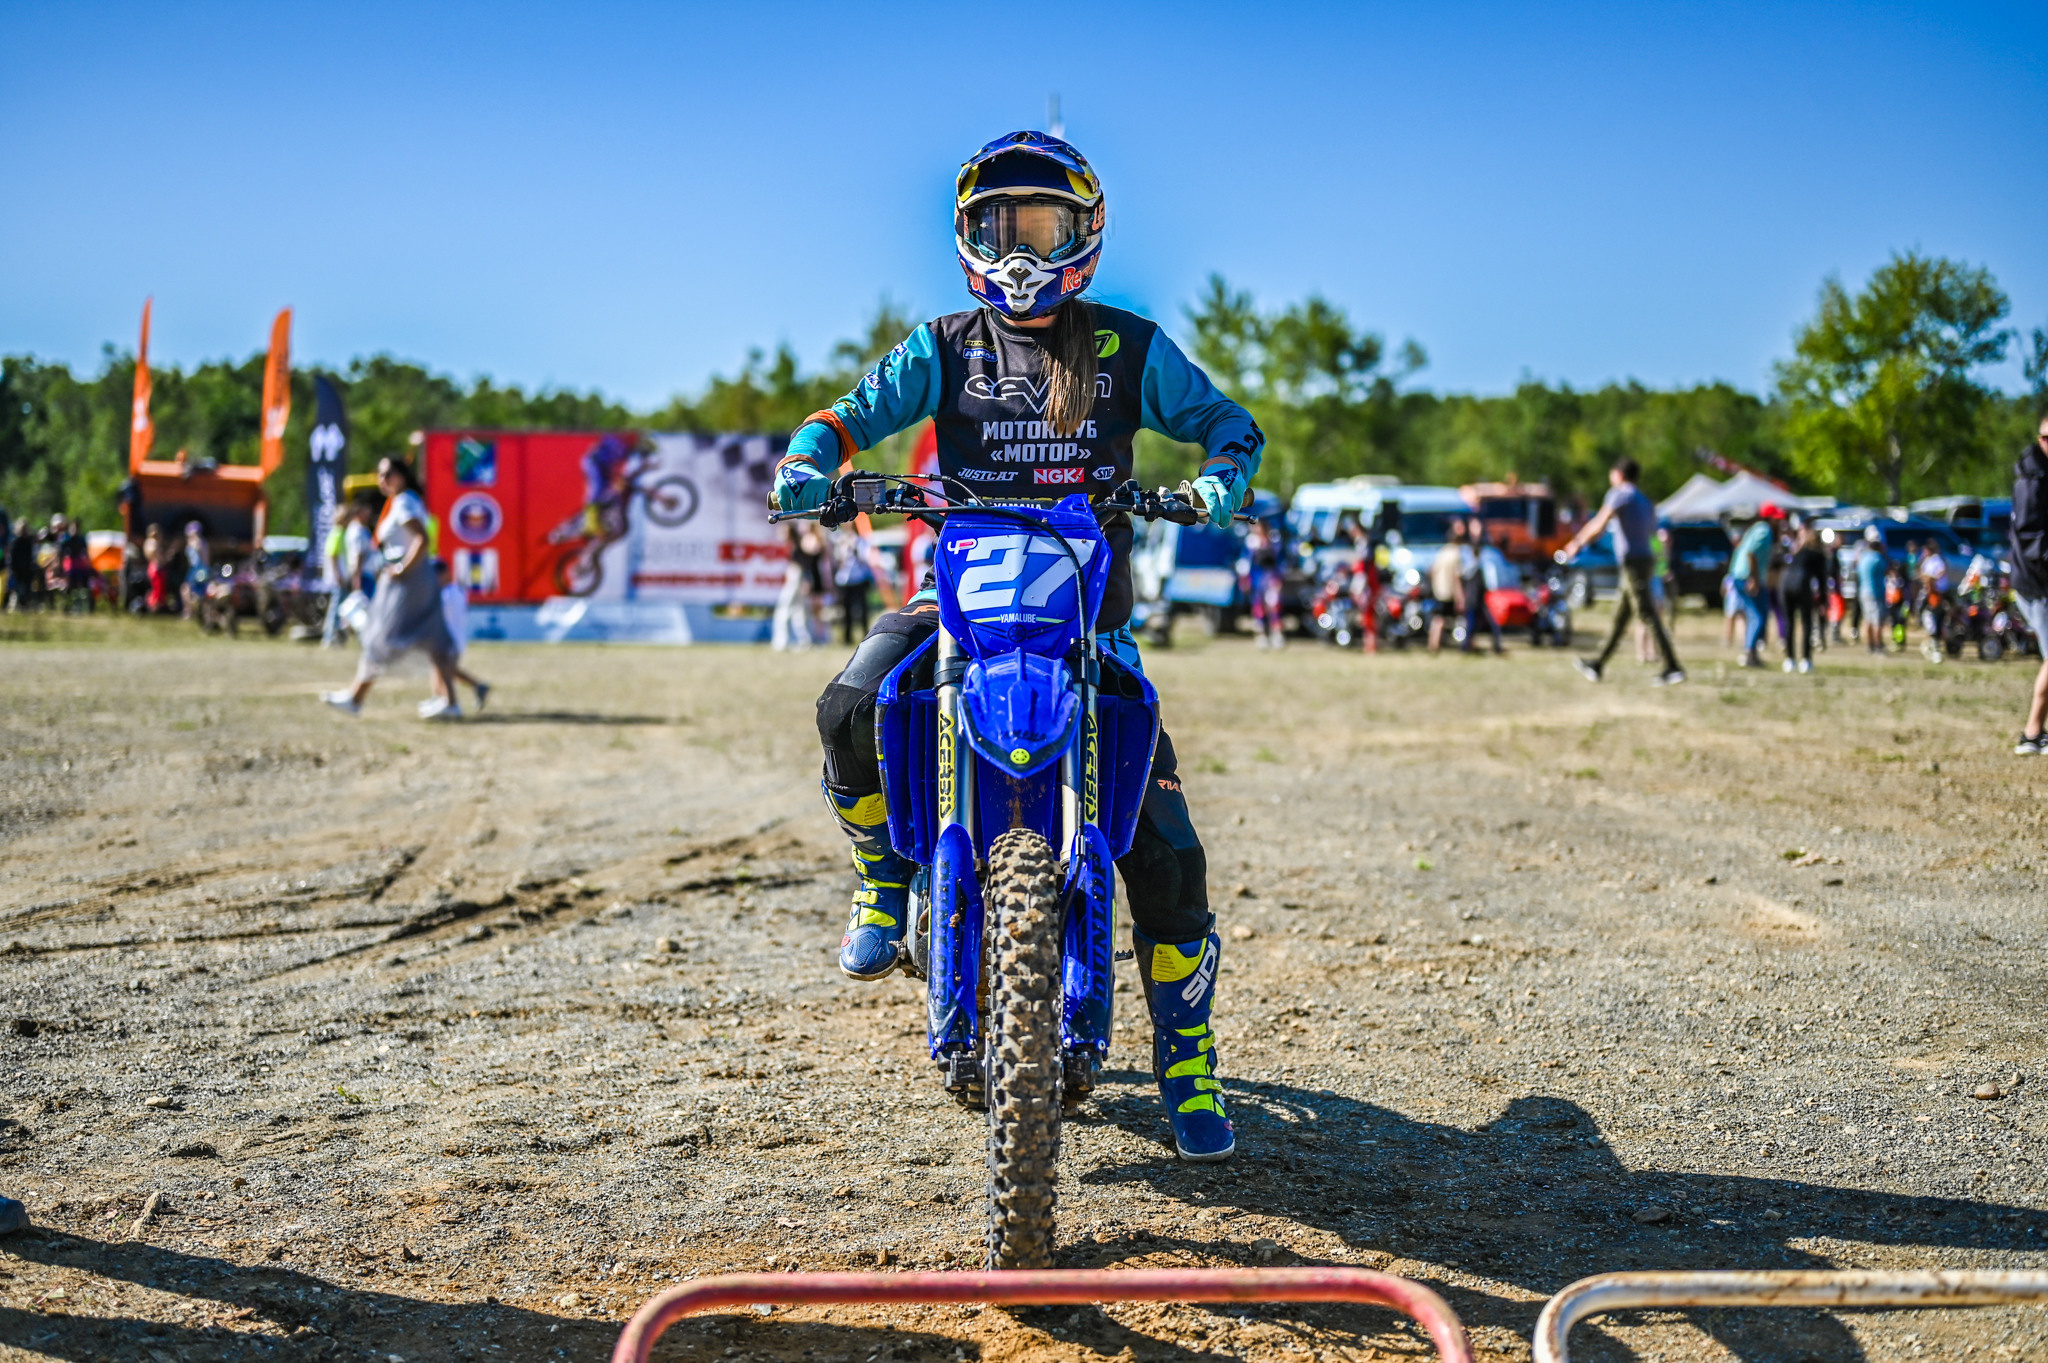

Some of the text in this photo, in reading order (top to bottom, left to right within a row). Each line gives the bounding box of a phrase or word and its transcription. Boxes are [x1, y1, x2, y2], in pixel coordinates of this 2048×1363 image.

[1034, 468, 1079, 484] NGK
[957, 534, 1097, 613] 27
[1000, 613, 1037, 624] YAMALUBE
[938, 711, 954, 820] ACERBIS
